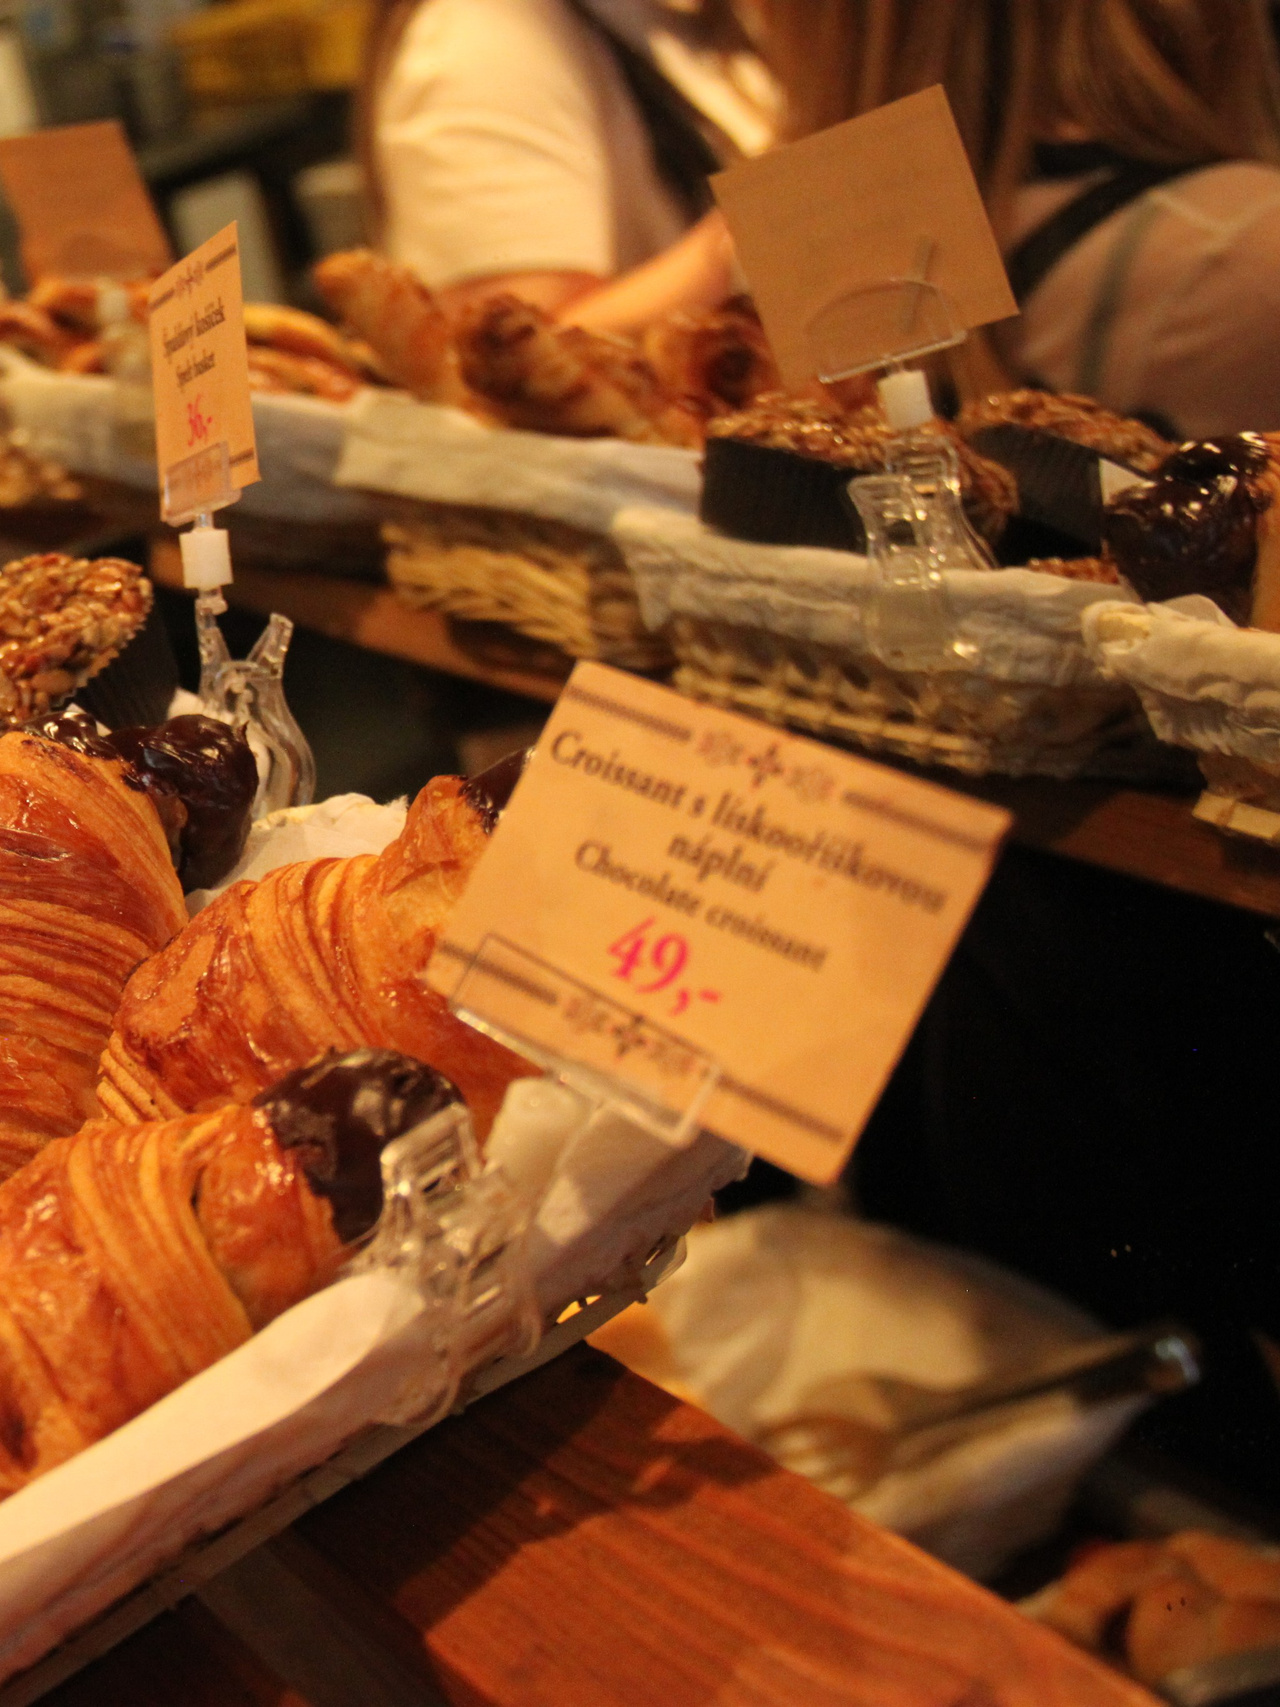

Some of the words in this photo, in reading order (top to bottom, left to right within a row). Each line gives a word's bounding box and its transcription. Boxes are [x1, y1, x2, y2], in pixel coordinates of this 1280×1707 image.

[550, 729, 688, 808] Croissant
[574, 839, 702, 917] Chocolate
[704, 904, 829, 973] croissant
[667, 833, 776, 893] náplní
[606, 914, 723, 1019] 49,-
